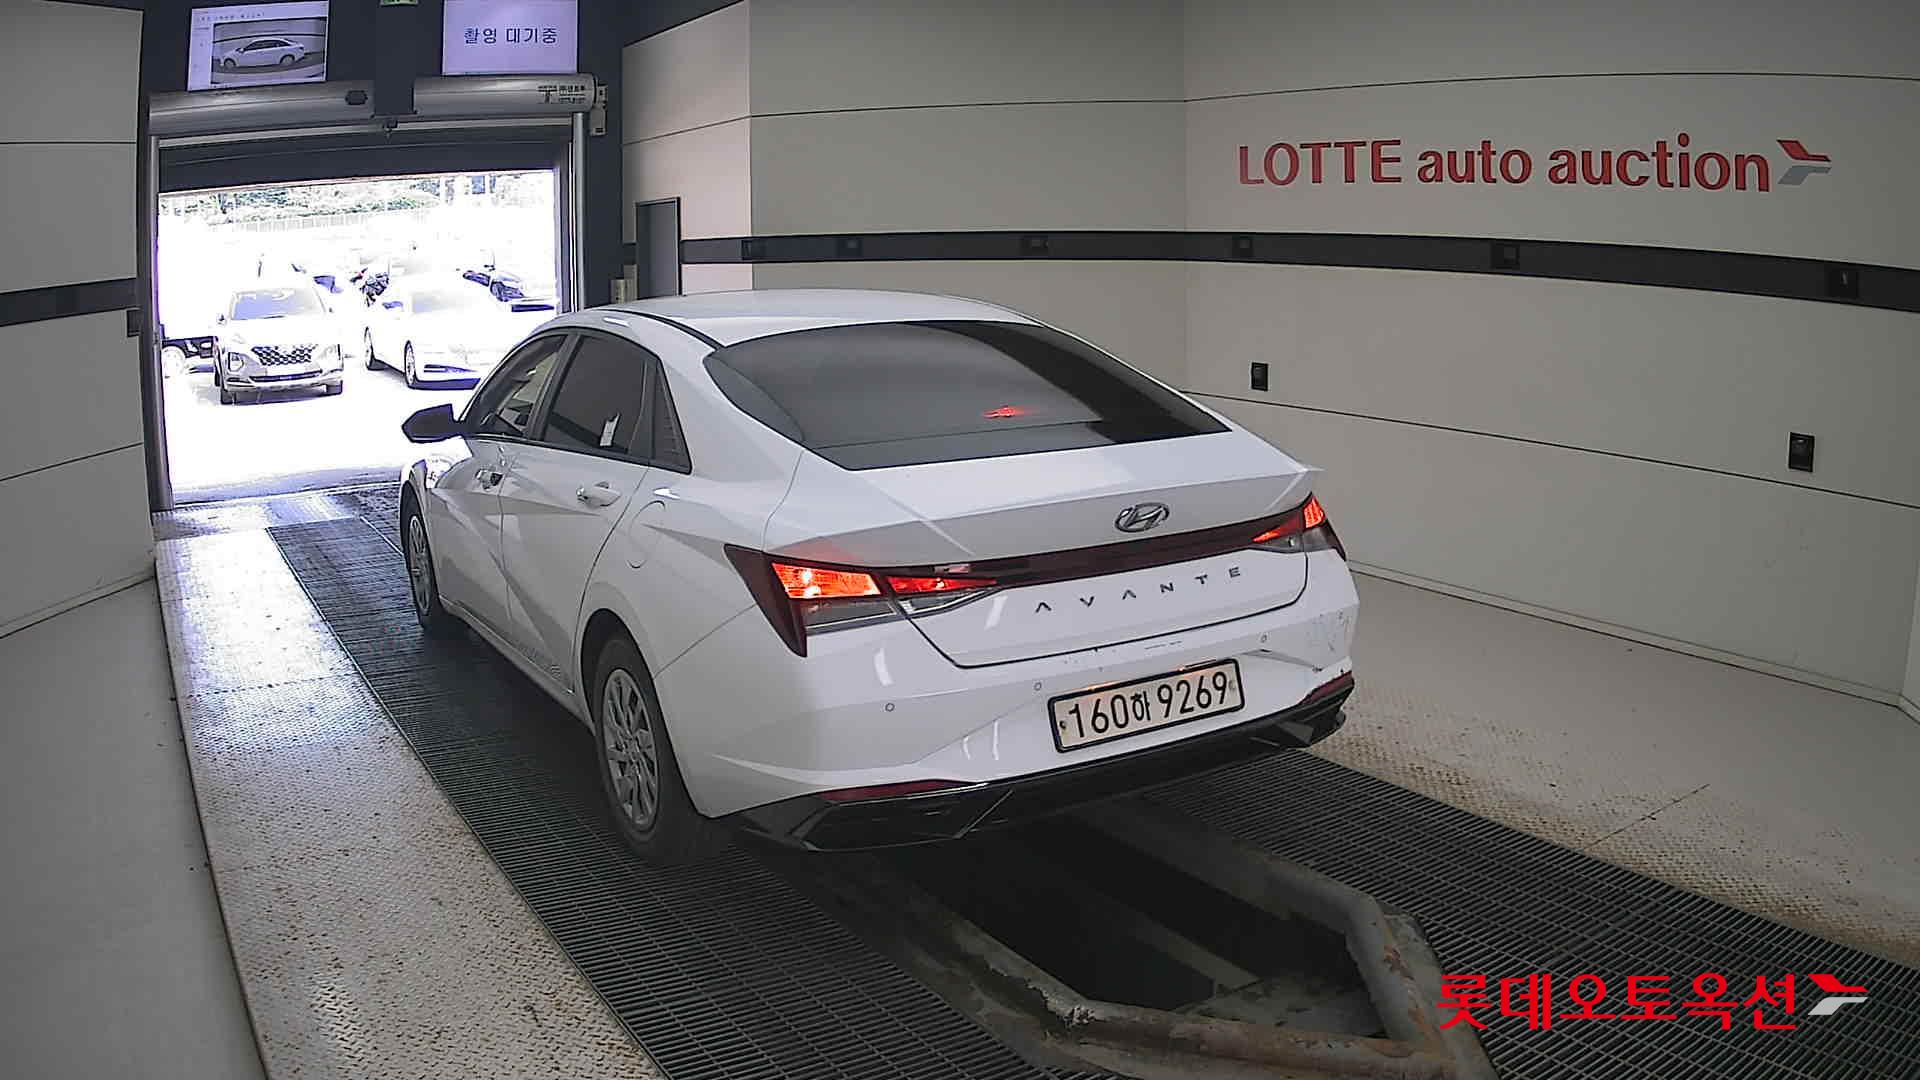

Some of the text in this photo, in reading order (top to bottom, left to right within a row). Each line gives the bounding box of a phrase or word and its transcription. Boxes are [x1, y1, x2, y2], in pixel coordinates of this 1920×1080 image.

[464, 27, 558, 44] 촬영 대기중
[1238, 132, 1771, 193] LOTTE auto auction
[1035, 566, 1241, 613] AVANTE
[1068, 670, 1228, 738] 160하 9269
